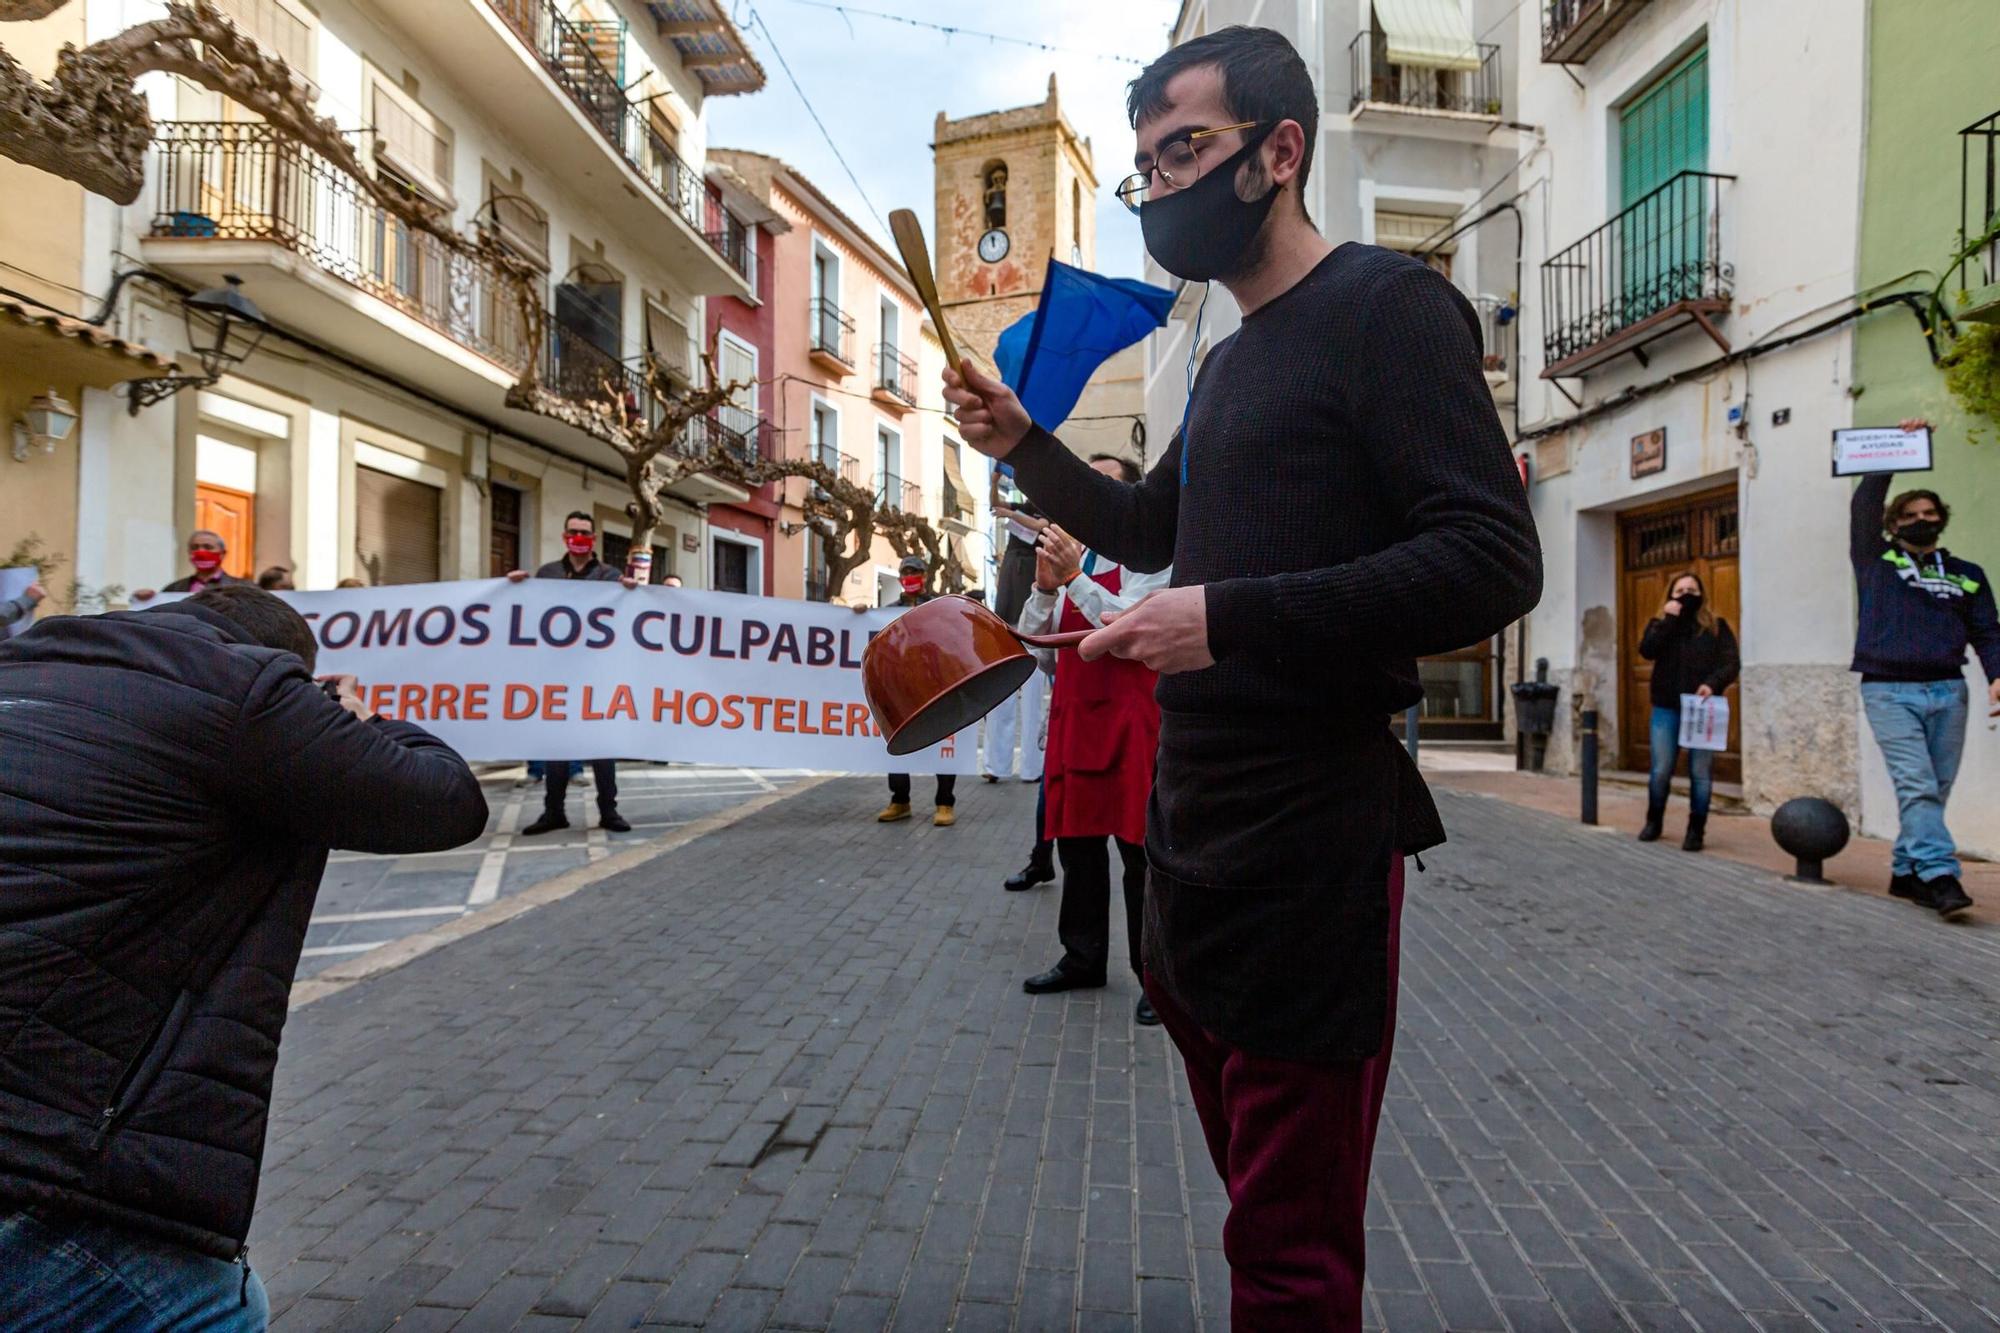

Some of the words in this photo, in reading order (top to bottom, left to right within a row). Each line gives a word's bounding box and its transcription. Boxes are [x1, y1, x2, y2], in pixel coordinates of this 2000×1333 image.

[303, 603, 490, 649] OMOS
[508, 604, 616, 649] LOS
[631, 610, 880, 669] CULPABL
[503, 683, 568, 720] DE
[581, 684, 639, 721] LA
